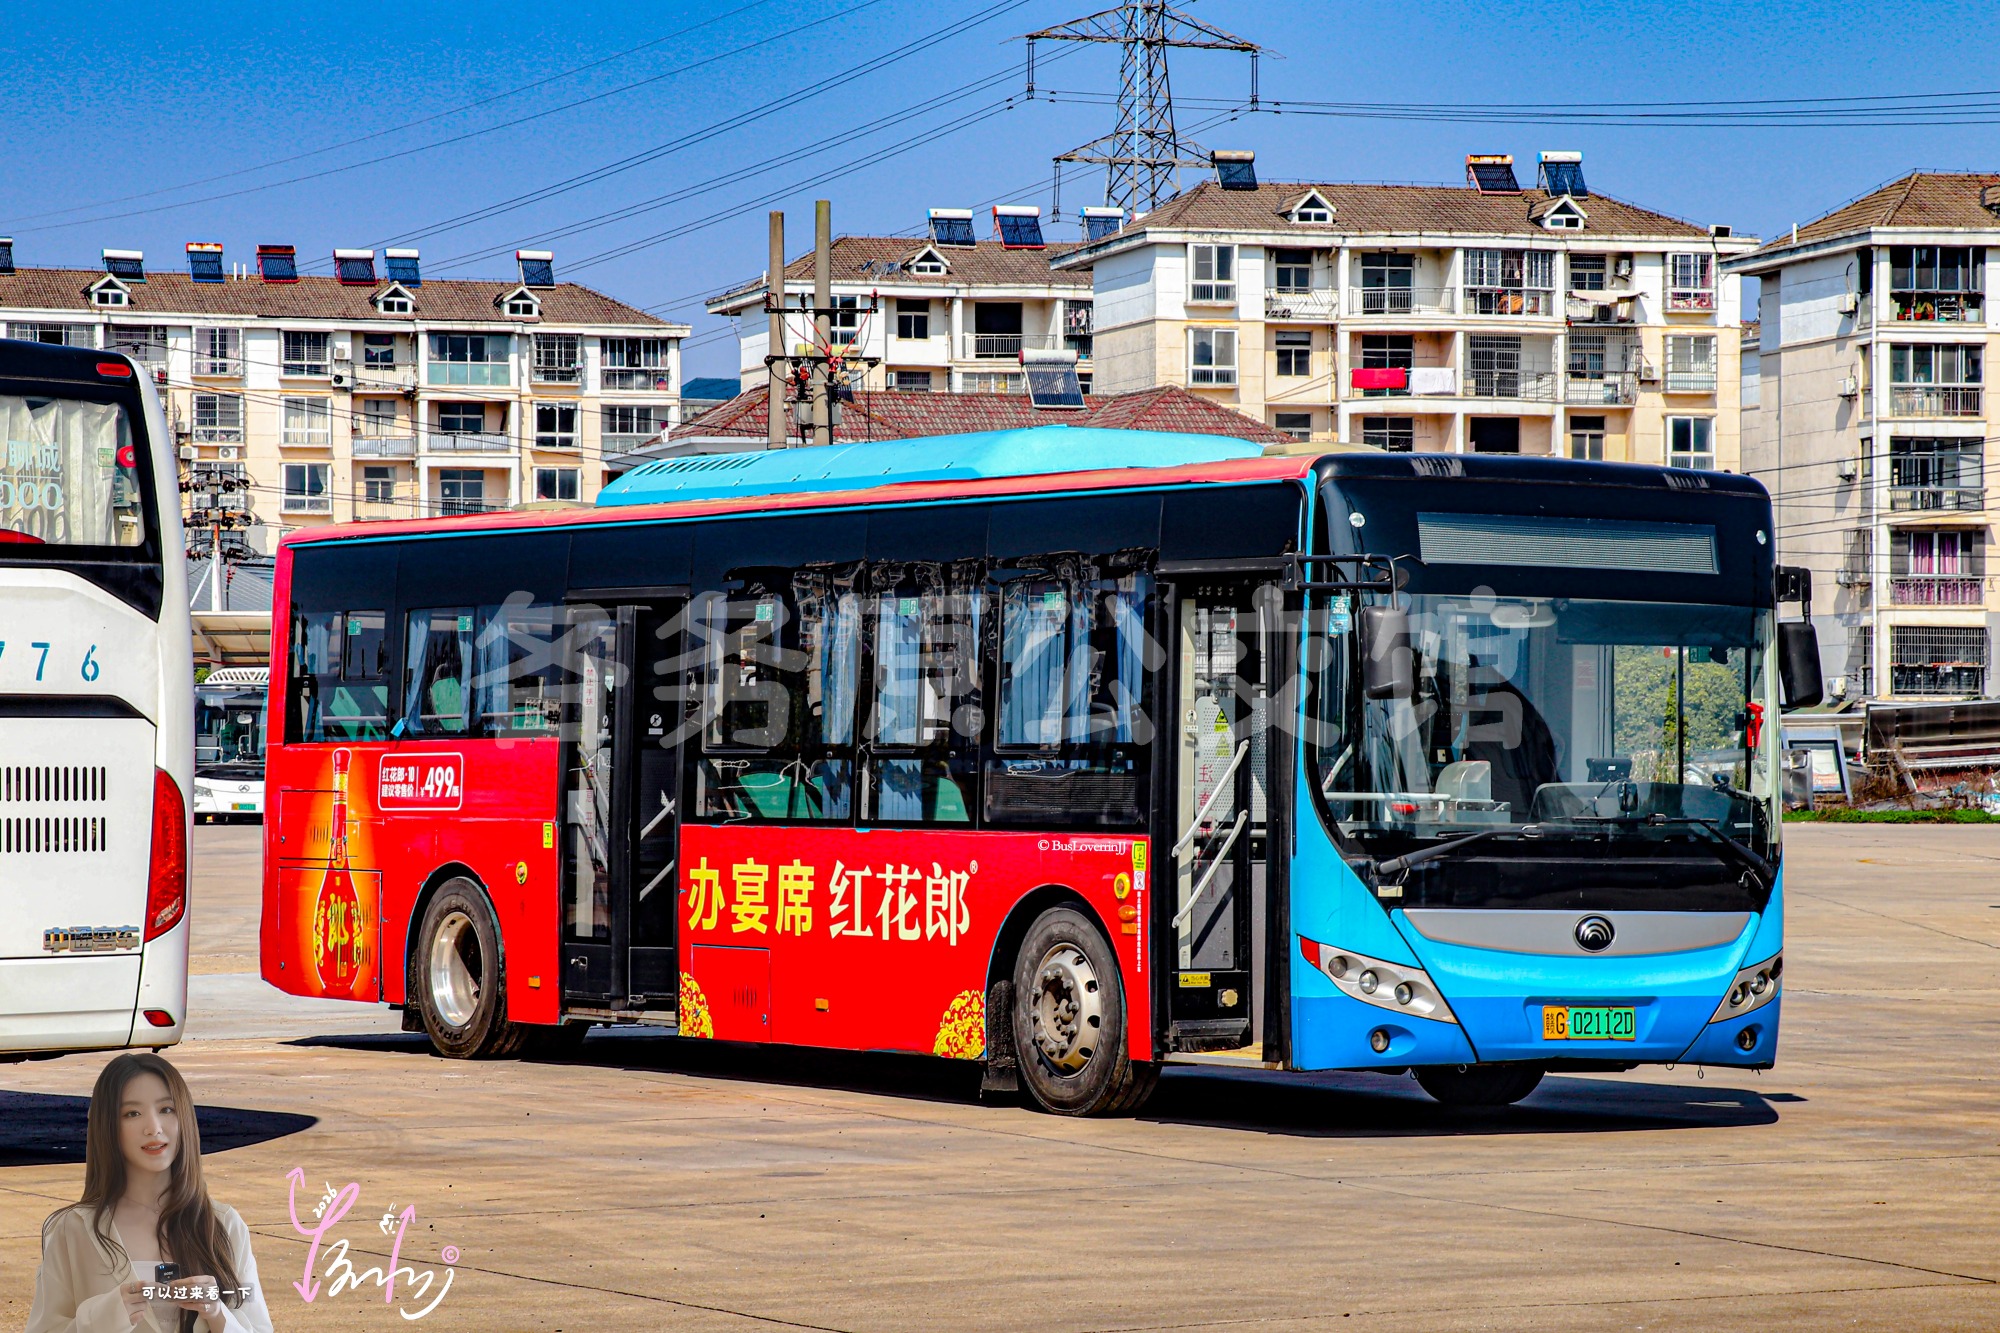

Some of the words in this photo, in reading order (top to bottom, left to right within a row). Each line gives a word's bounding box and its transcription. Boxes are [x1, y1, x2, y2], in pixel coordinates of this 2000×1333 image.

[0, 641, 100, 681] 76
[381, 784, 414, 797] 建议零售价
[688, 857, 815, 936] 办宴席
